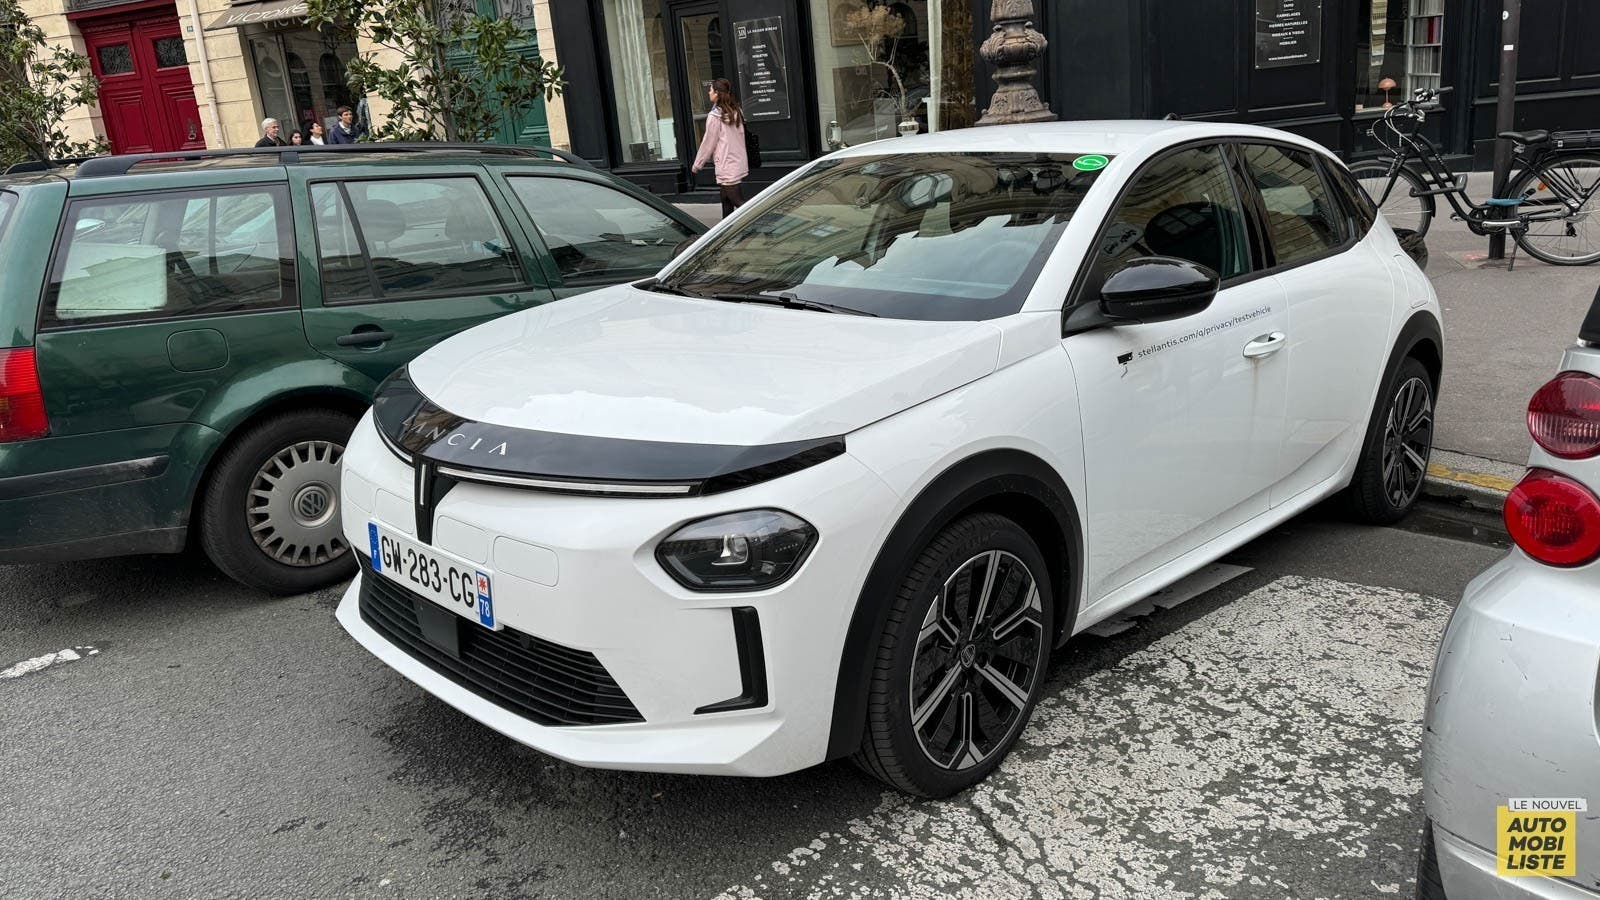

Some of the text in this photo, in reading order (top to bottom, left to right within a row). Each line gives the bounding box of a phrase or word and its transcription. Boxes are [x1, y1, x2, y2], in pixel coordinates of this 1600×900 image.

[1138, 305, 1271, 358] stellantis.com/q/privacy/testvehicle
[381, 535, 474, 608] GW-283-CG
[480, 598, 490, 618] 78
